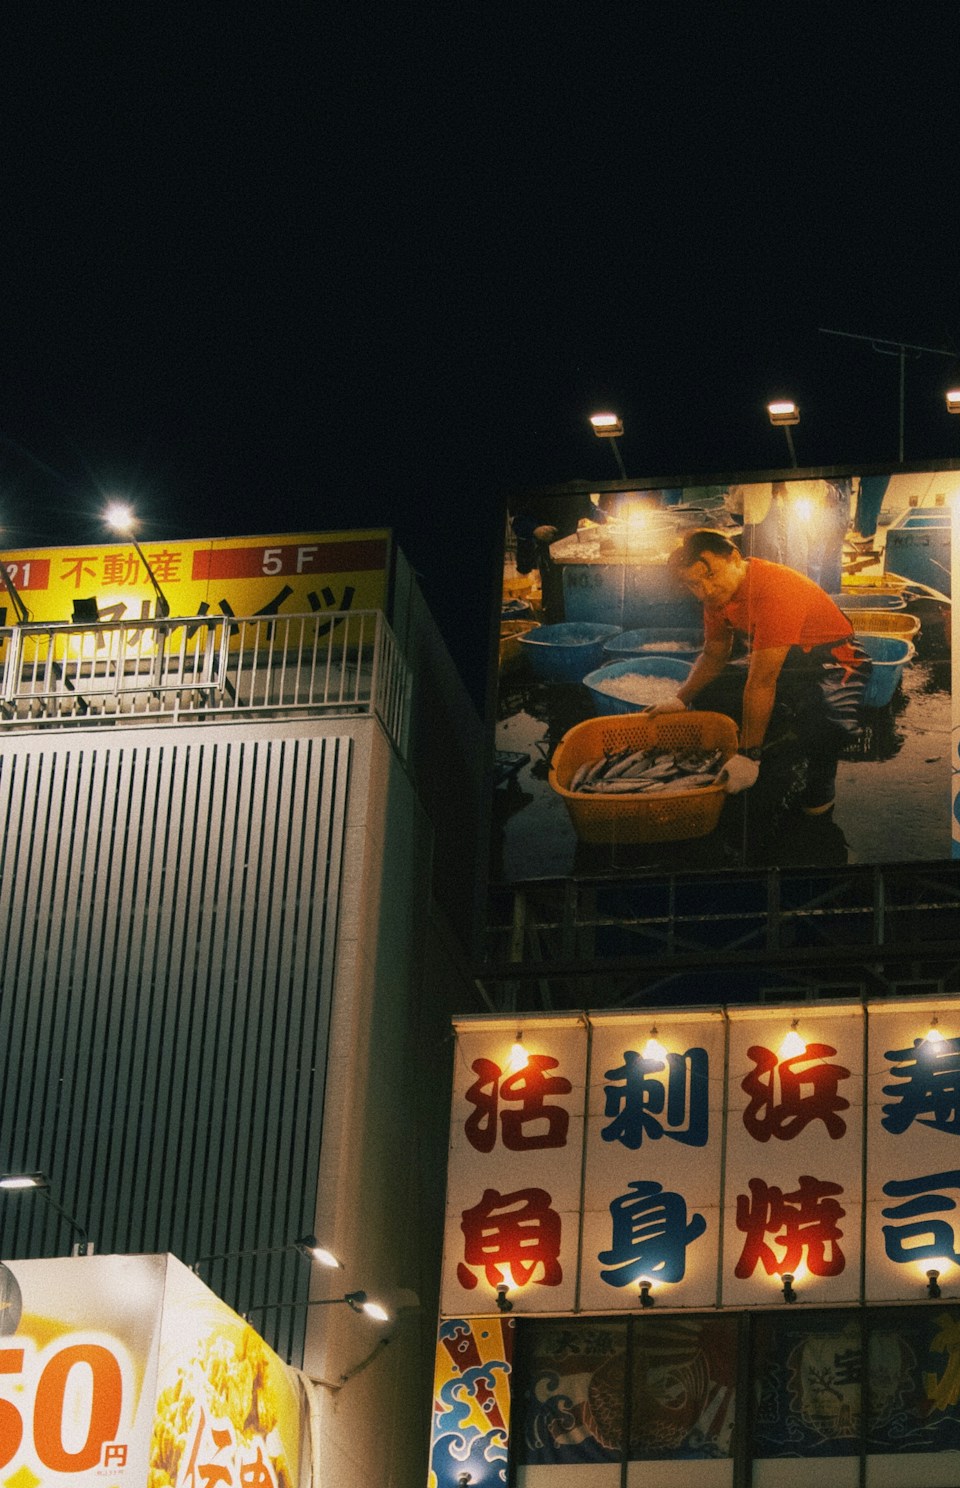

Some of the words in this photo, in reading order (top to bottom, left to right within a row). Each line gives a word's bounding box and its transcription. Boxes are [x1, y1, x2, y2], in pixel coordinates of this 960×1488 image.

[61, 549, 182, 589] 不動産
[457, 1055, 573, 1290] 活魚
[598, 1047, 709, 1288] 刺身
[734, 1043, 851, 1279] 浜焼
